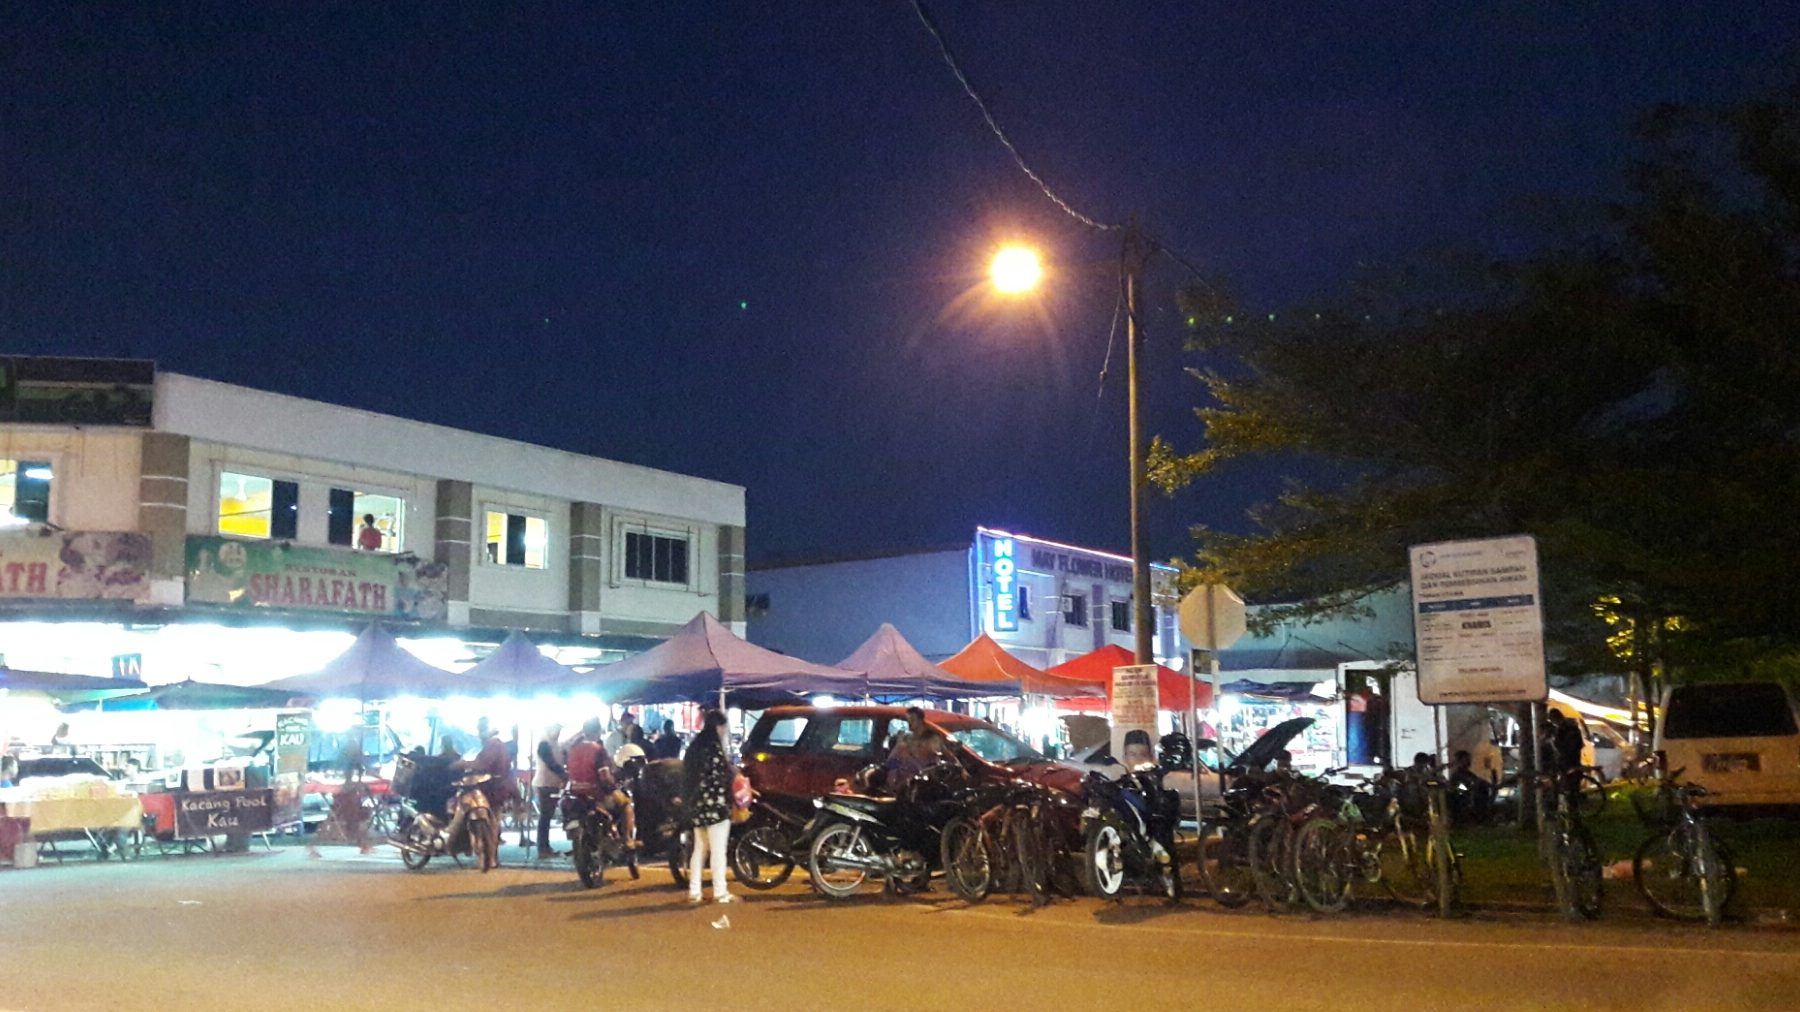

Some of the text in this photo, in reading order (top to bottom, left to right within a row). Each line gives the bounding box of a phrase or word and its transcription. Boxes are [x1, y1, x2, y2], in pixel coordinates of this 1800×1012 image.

[285, 563, 357, 577] RESTORAN
[1031, 548, 1055, 570] MAY
[1058, 554, 1103, 579] FLOWER
[0, 562, 47, 593] TH
[994, 539, 1014, 629] HOTEL
[249, 573, 387, 610] SHARAFATH
[279, 732, 305, 746] KAU
[181, 798, 231, 812] Kacang
[207, 812, 239, 828] Kau
